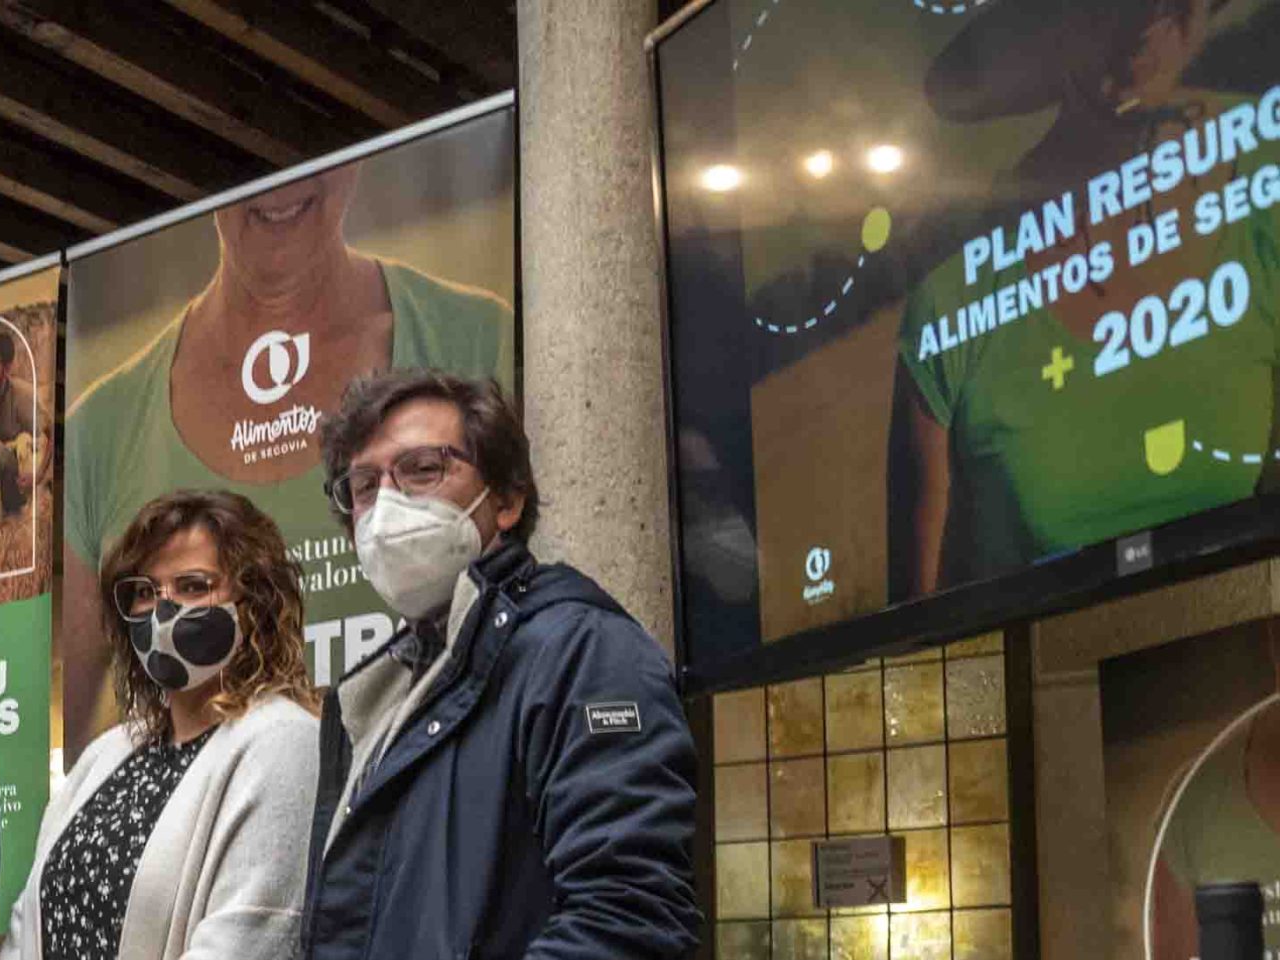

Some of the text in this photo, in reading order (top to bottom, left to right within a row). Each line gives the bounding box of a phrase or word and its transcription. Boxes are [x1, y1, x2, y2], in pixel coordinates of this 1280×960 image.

[919, 163, 1280, 361] ALIMENTOS DE SEG
[963, 191, 1075, 286] PLAN
[1092, 260, 1251, 378] 2020
[230, 403, 322, 451] Alimentos
[244, 438, 308, 465] DE SEGOVIA
[303, 611, 407, 688] TR
